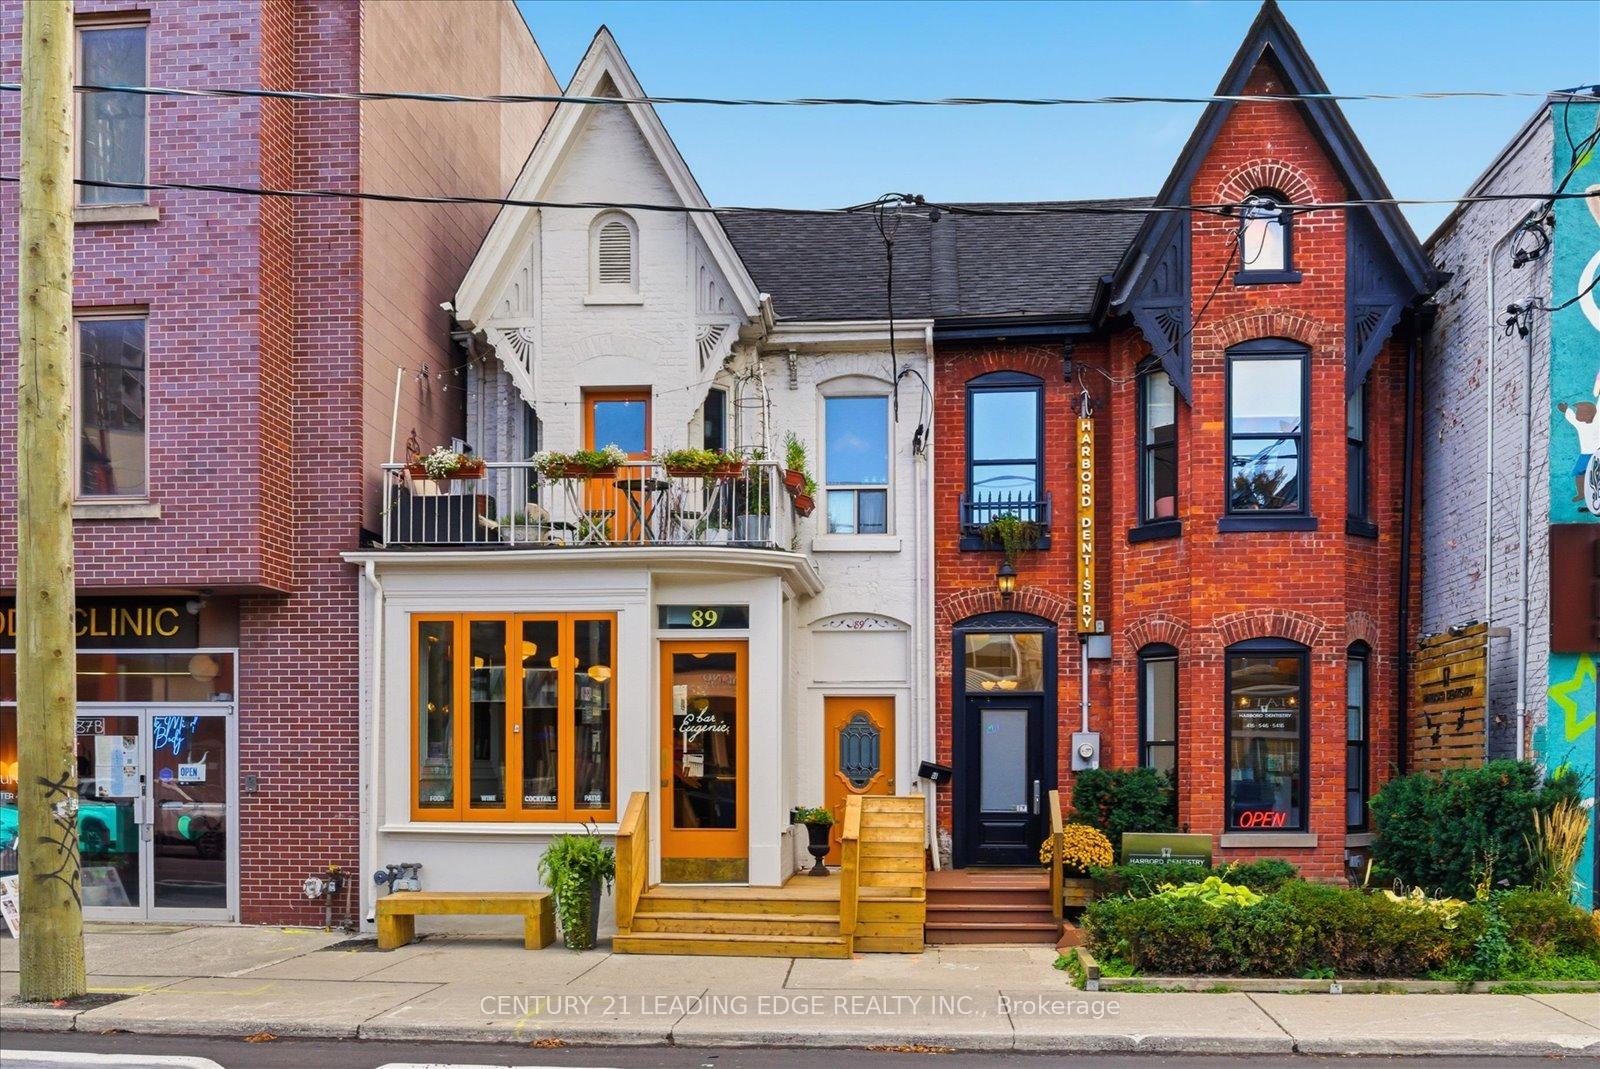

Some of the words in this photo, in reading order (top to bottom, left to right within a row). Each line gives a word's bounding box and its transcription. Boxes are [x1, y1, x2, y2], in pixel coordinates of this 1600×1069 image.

[1081, 421, 1092, 507] HARBORD
[1081, 518, 1092, 628] DENTISTRY
[691, 610, 718, 628] 89
[853, 620, 866, 630] 89
[696, 705, 717, 723] bar
[180, 767, 198, 777] OPEN
[584, 794, 601, 802] PATIO
[1239, 811, 1286, 828] OPEN
